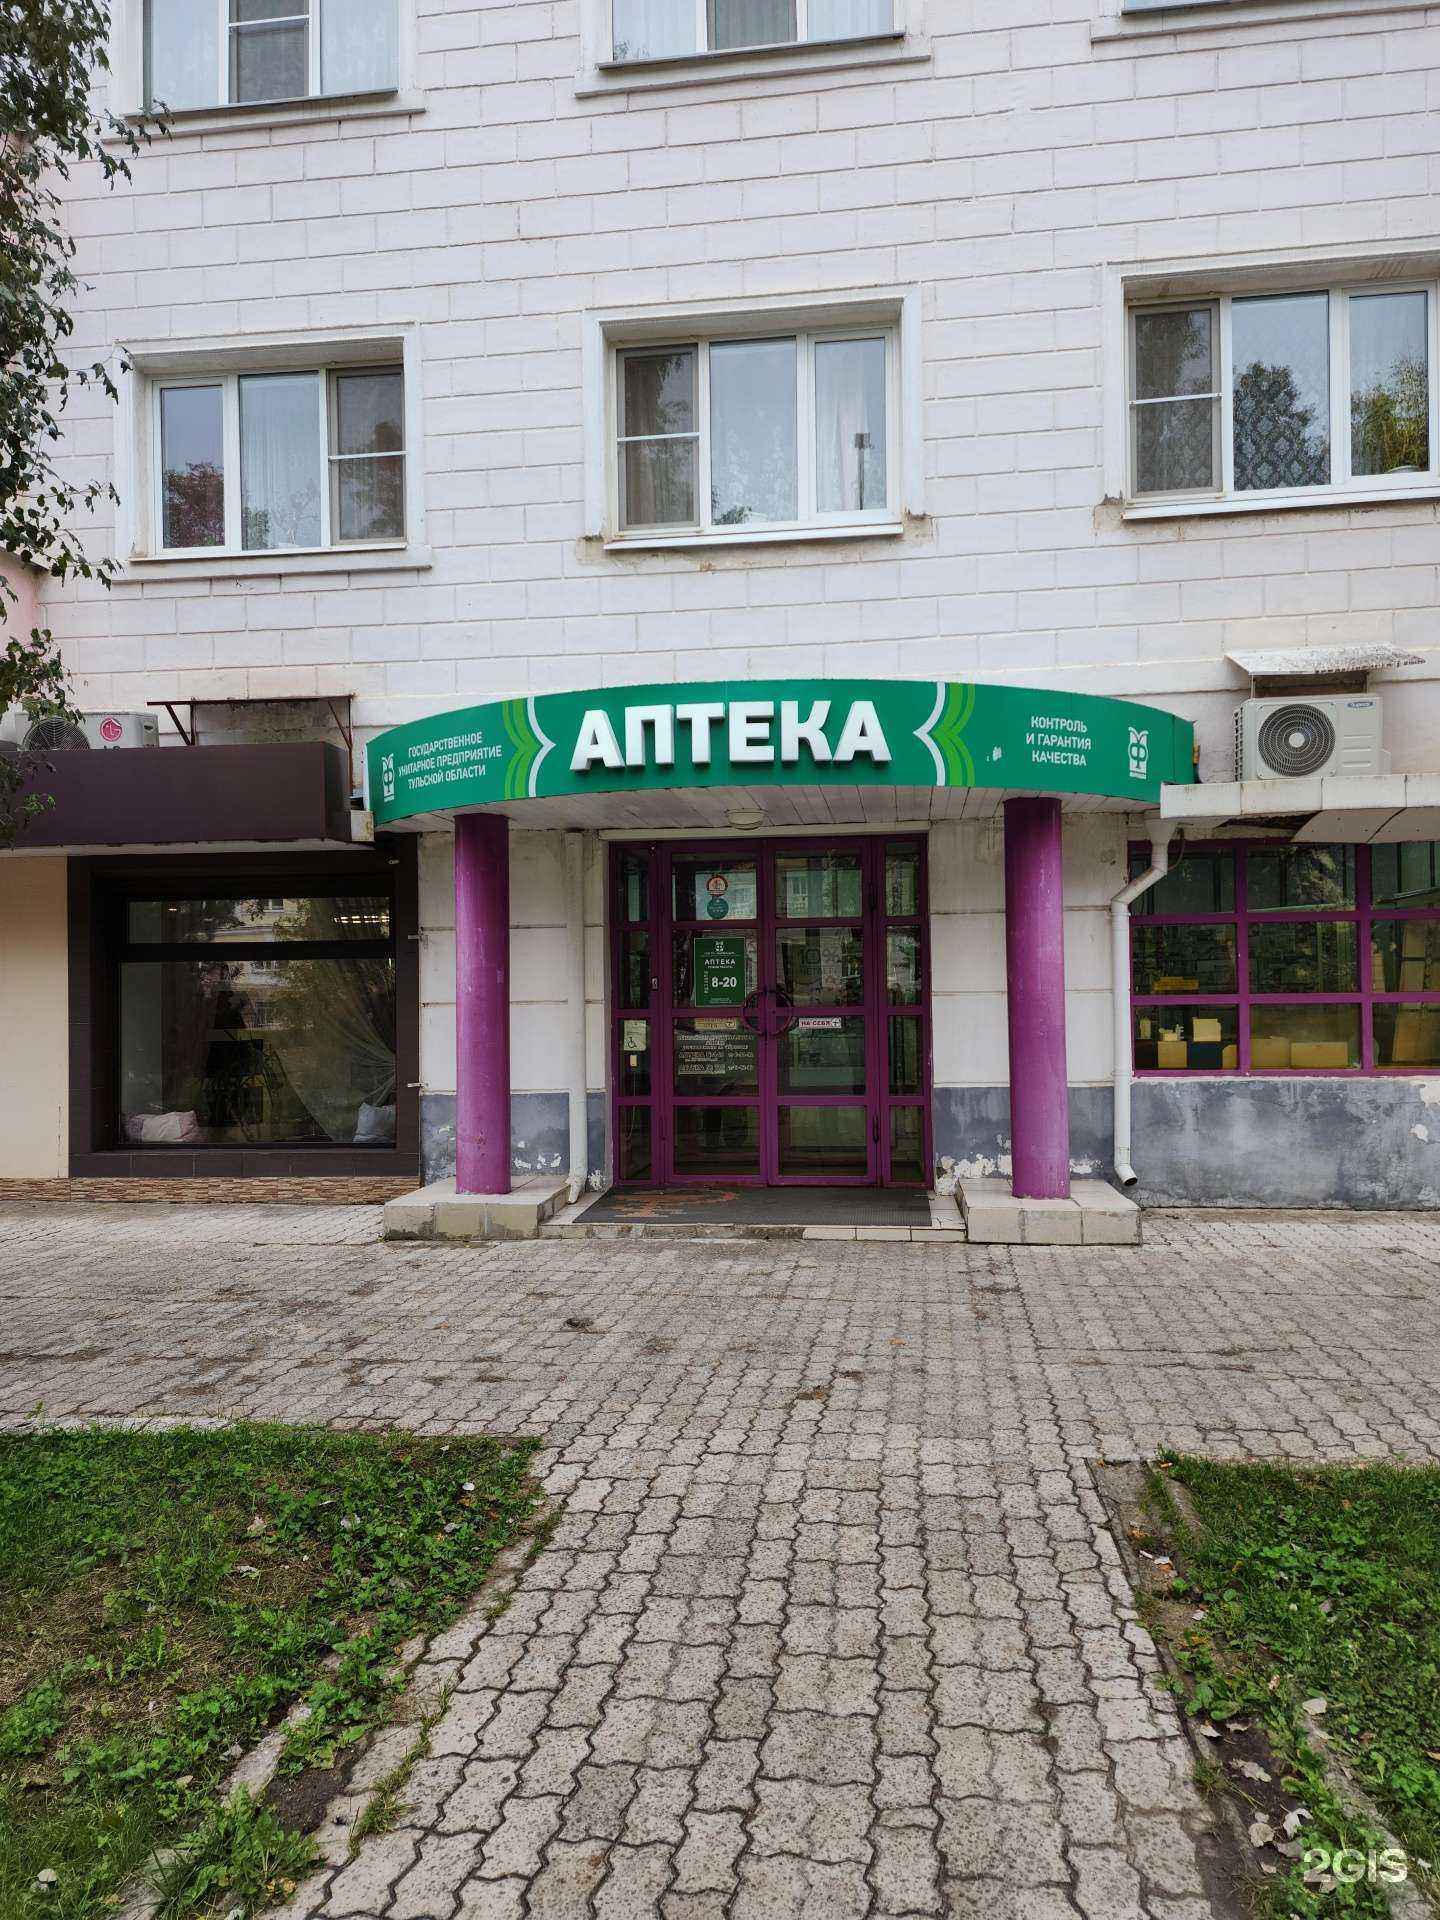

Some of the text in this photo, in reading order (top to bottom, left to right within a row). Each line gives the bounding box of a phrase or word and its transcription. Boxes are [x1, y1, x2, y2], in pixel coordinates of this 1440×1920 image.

[1031, 716, 1088, 733] КОНТРОЛЬ
[569, 700, 892, 772] АПТЕКА
[1026, 733, 1092, 750] И ГАРАНТИЯ
[408, 732, 483, 758] ГОСУДАРСТВЕННОЕ
[398, 745, 502, 777] УНИТАРНОЕ ПРЕДПРИЯТИЕ
[1032, 750, 1087, 766] КАЧЕСТВА
[407, 765, 486, 790] ТУЛЬСКОЙ ОБЛАСТИ
[704, 958, 736, 966] АПТЕКА
[711, 976, 738, 988] 8-20
